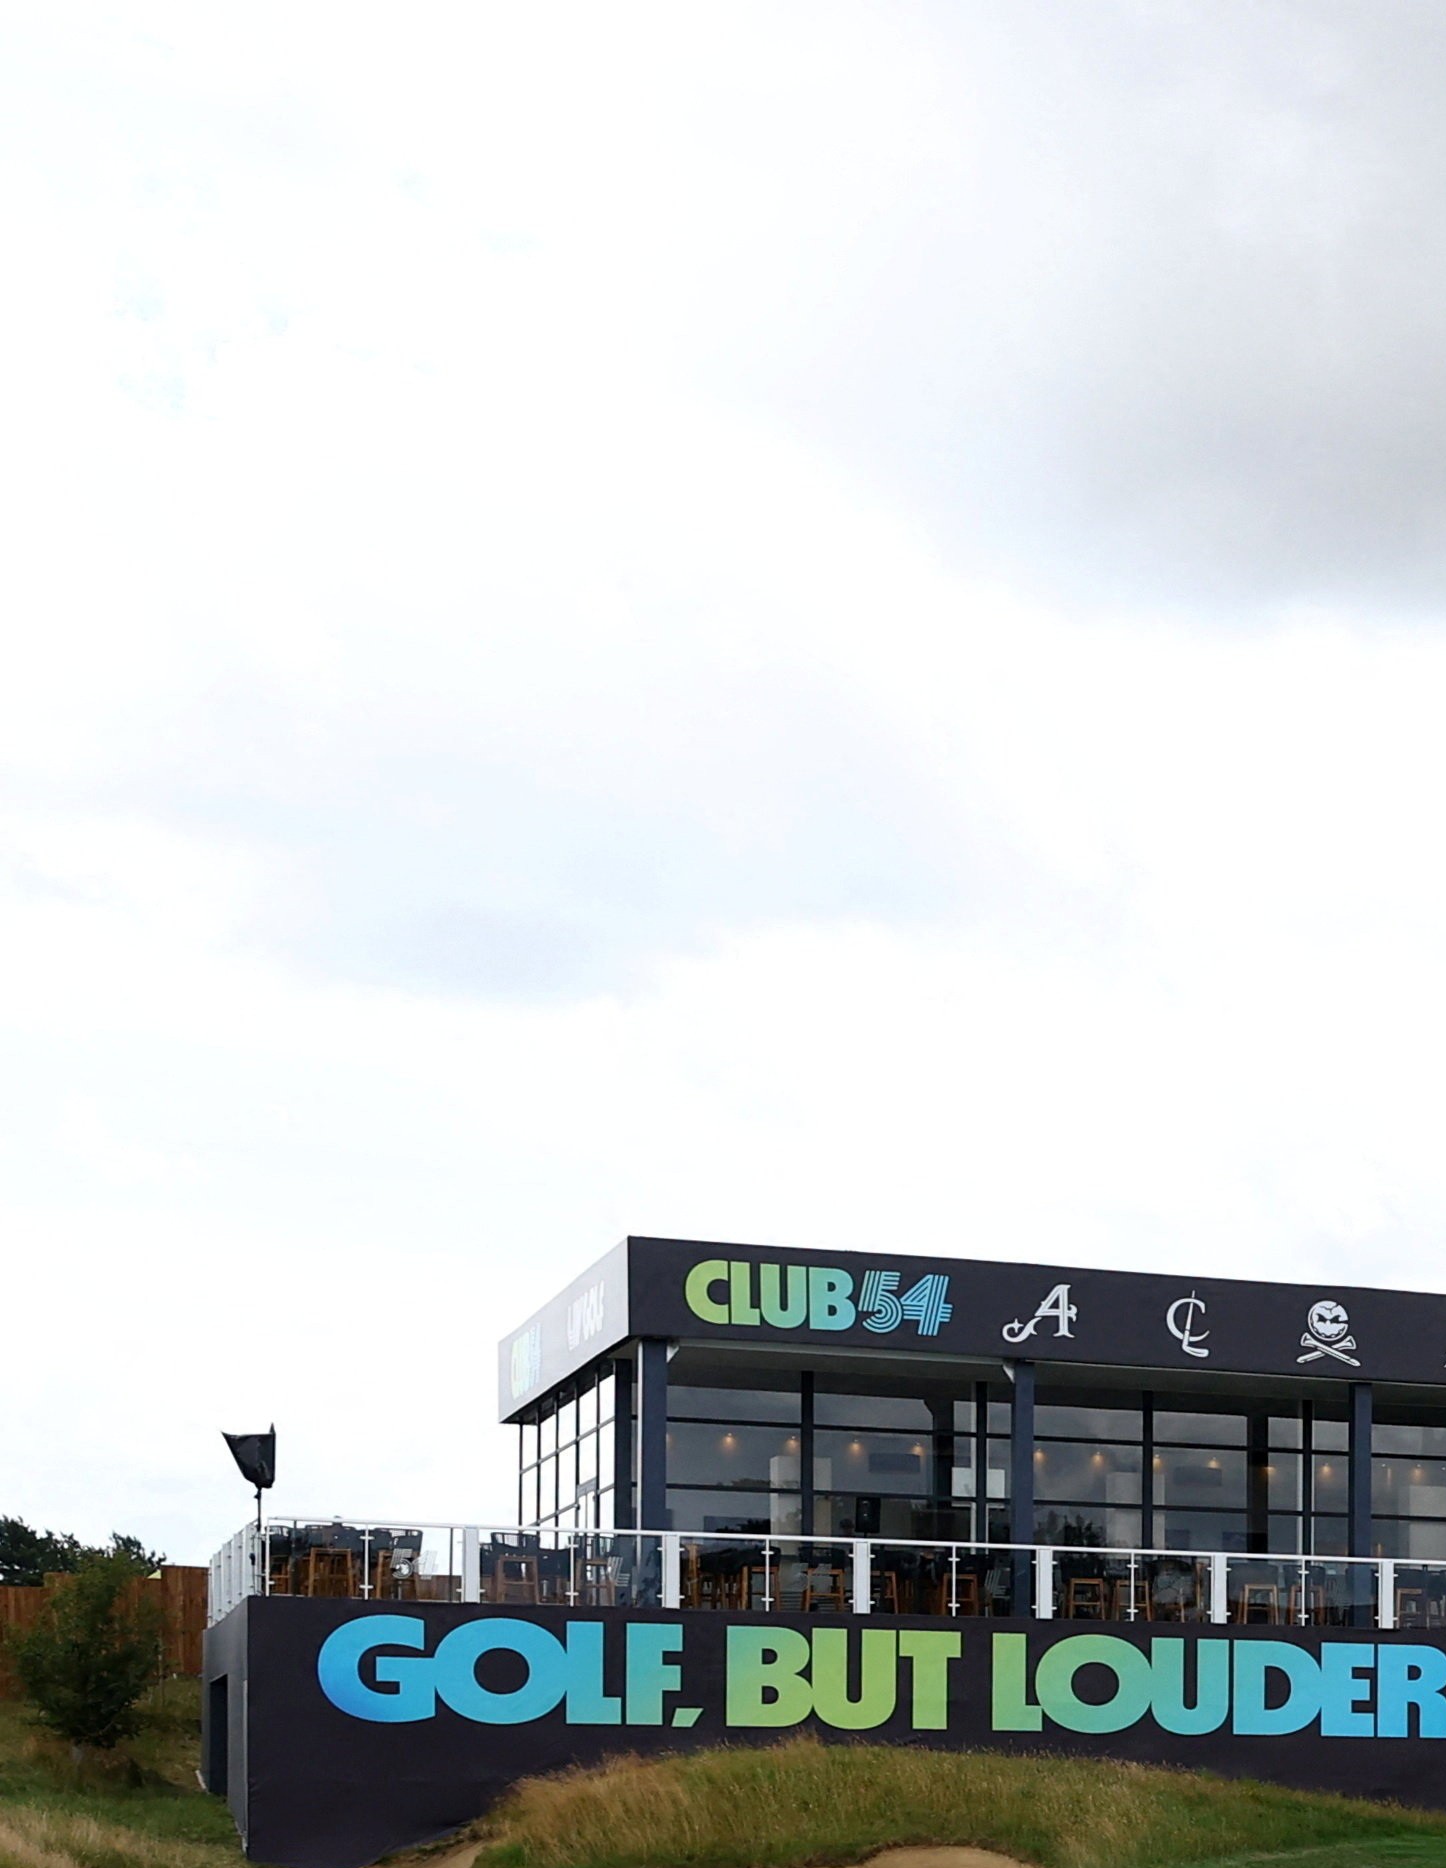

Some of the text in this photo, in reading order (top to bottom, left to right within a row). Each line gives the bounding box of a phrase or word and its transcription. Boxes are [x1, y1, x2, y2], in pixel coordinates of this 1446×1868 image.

[685, 1259, 856, 1332] CLUB
[317, 1614, 704, 1727] GOLF,
[726, 1625, 961, 1730] BUT
